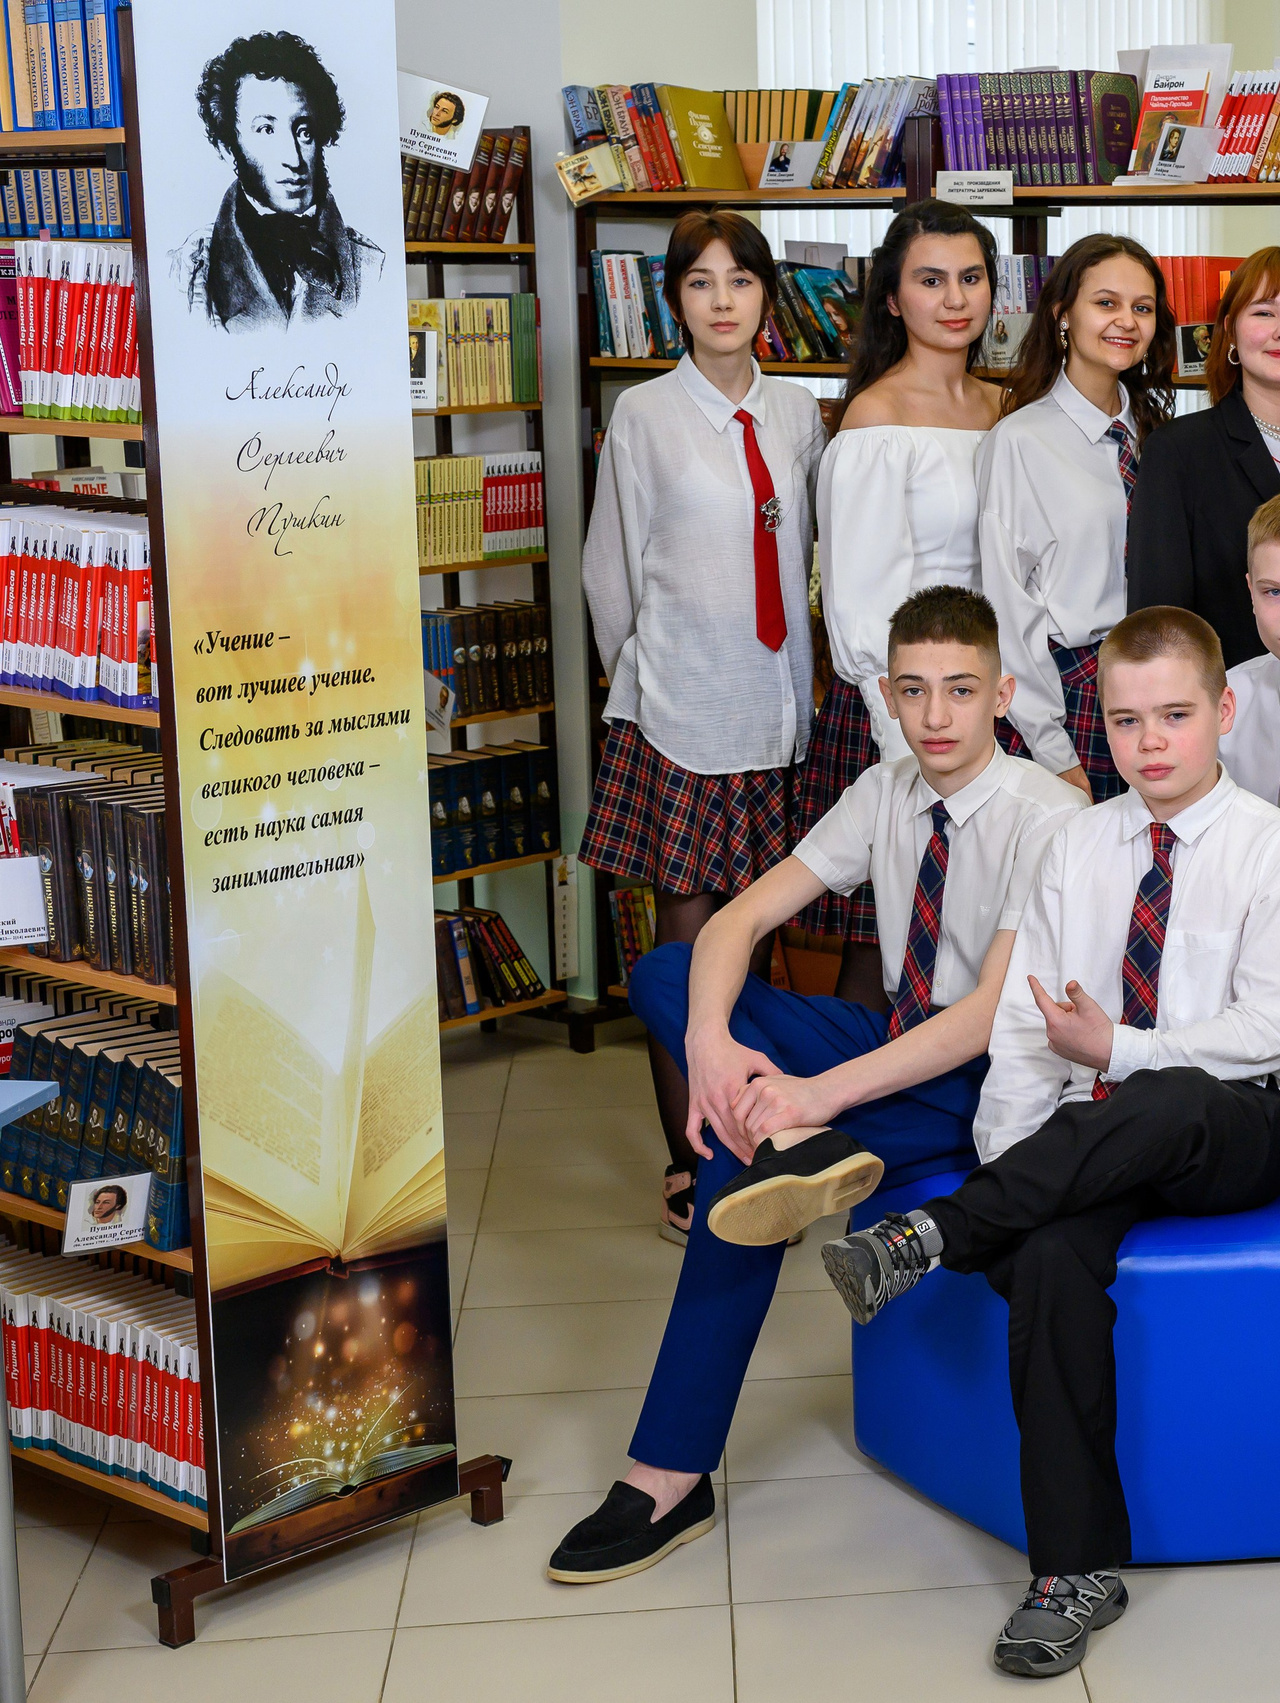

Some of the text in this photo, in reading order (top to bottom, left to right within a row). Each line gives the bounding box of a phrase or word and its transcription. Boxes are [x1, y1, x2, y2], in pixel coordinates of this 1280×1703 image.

[30, 48, 38, 108] ЛЕРМОНТОВ
[41, 46, 49, 107] ЛЕРМОНТОВ
[60, 44, 69, 106] ЛЕРМОНТОВ
[71, 43, 80, 105] ЛЕРМОНТОВ
[90, 44, 99, 105] ЛЕРМОНТОВ
[1154, 81, 1184, 90] Байрон
[564, 89, 584, 136] ДЭН БРАУН
[597, 89, 608, 108] ДЭН
[611, 90, 622, 110] ДЭН
[617, 110, 630, 137] БРАУН
[418, 141, 457, 158] Сергеевич
[1224, 115, 1236, 138] Байрон
[1233, 114, 1245, 138] Байрон
[1240, 114, 1252, 138] Байрон
[562, 155, 588, 170] АНТАСТИКА
[22, 171, 35, 220] БУЛГАКОВ
[41, 171, 53, 220] БУЛГАКОВ
[60, 172, 71, 221] БУЛГАКОВ
[76, 171, 88, 220] БУЛГАКОВ
[92, 172, 103, 221] БУЛГАКОВ
[107, 172, 117, 222] БУЛГАКОВ
[42, 289, 50, 348] Лермонтов
[58, 291, 68, 350] Лермонтов
[78, 291, 89, 350] Лермонтов
[90, 292, 100, 351] Лермонтов
[100, 293, 111, 352] Лермонтов
[108, 293, 118, 352] Лермонтов
[124, 293, 135, 353] Лермонтов
[226, 362, 352, 421] Александр
[237, 430, 347, 490] Сергеевич
[74, 484, 108, 494] АЛЫЕ
[7, 570, 15, 617] Некрасов
[29, 573, 37, 620] Некрасов
[37, 573, 45, 620] Некрасов
[48, 574, 56, 622] Некрасов
[64, 578, 73, 626] Некрасов
[70, 582, 78, 630] Некрасов
[194, 629, 273, 656] «Учение
[196, 665, 376, 704] вот лучшее учение.
[200, 720, 299, 752] Следовать
[305, 720, 323, 738] за
[328, 708, 411, 735] мыслями
[201, 768, 281, 800] великого
[287, 760, 365, 785] человека
[204, 805, 364, 848] есть наука самая
[212, 851, 365, 894] занимательная»
[74, 1232, 117, 1243] Александр
[120, 1227, 145, 1235] Сергее
[90, 1224, 123, 1233] Пушкин
